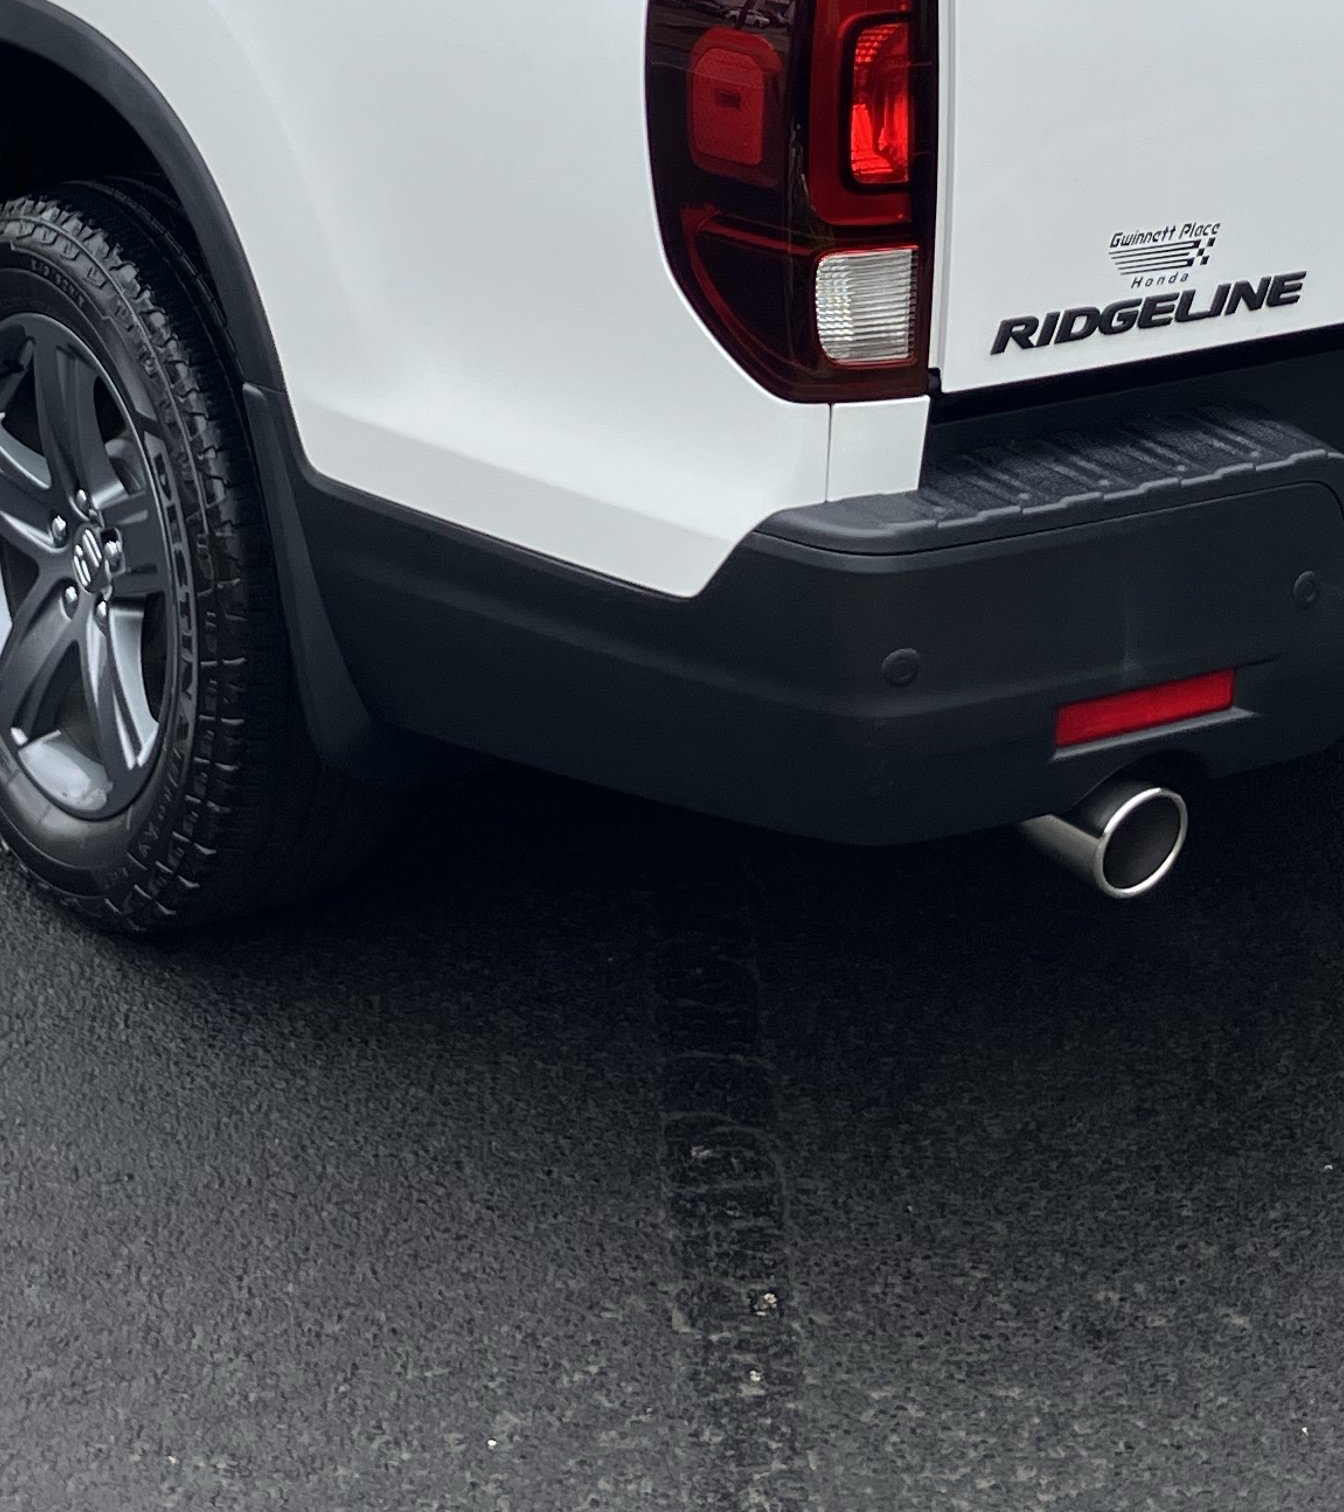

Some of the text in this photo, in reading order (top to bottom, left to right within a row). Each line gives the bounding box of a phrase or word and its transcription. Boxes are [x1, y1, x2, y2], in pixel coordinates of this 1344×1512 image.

[1109, 222, 1221, 249] Gwinnett Place
[1130, 272, 1190, 289] Honda
[989, 270, 1308, 356] RIDGELINE
